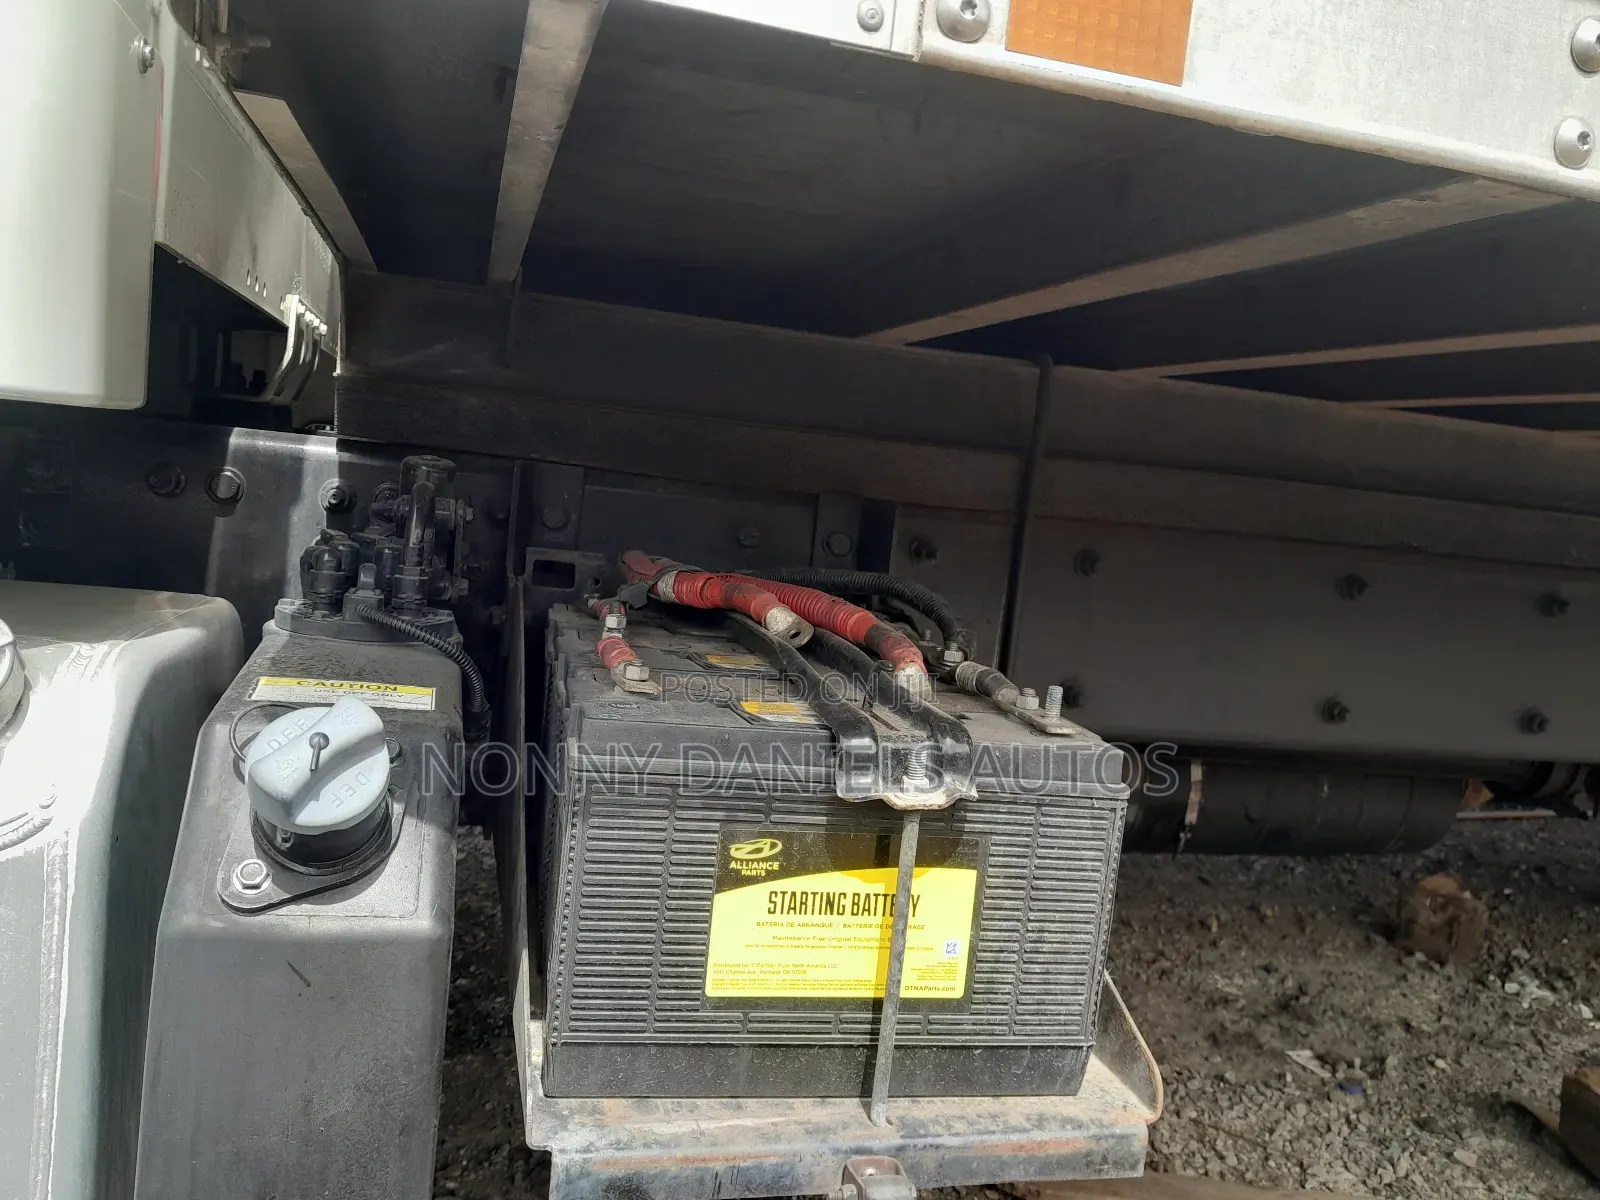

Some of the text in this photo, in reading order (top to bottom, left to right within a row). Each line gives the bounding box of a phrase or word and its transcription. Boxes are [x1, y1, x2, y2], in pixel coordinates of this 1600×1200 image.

[296, 680, 398, 692] CAUTION
[331, 771, 371, 808] DEF
[729, 860, 780, 870] ALLIANCE
[741, 869, 766, 877] PARTS
[767, 890, 921, 918] STARTING BATTEY
